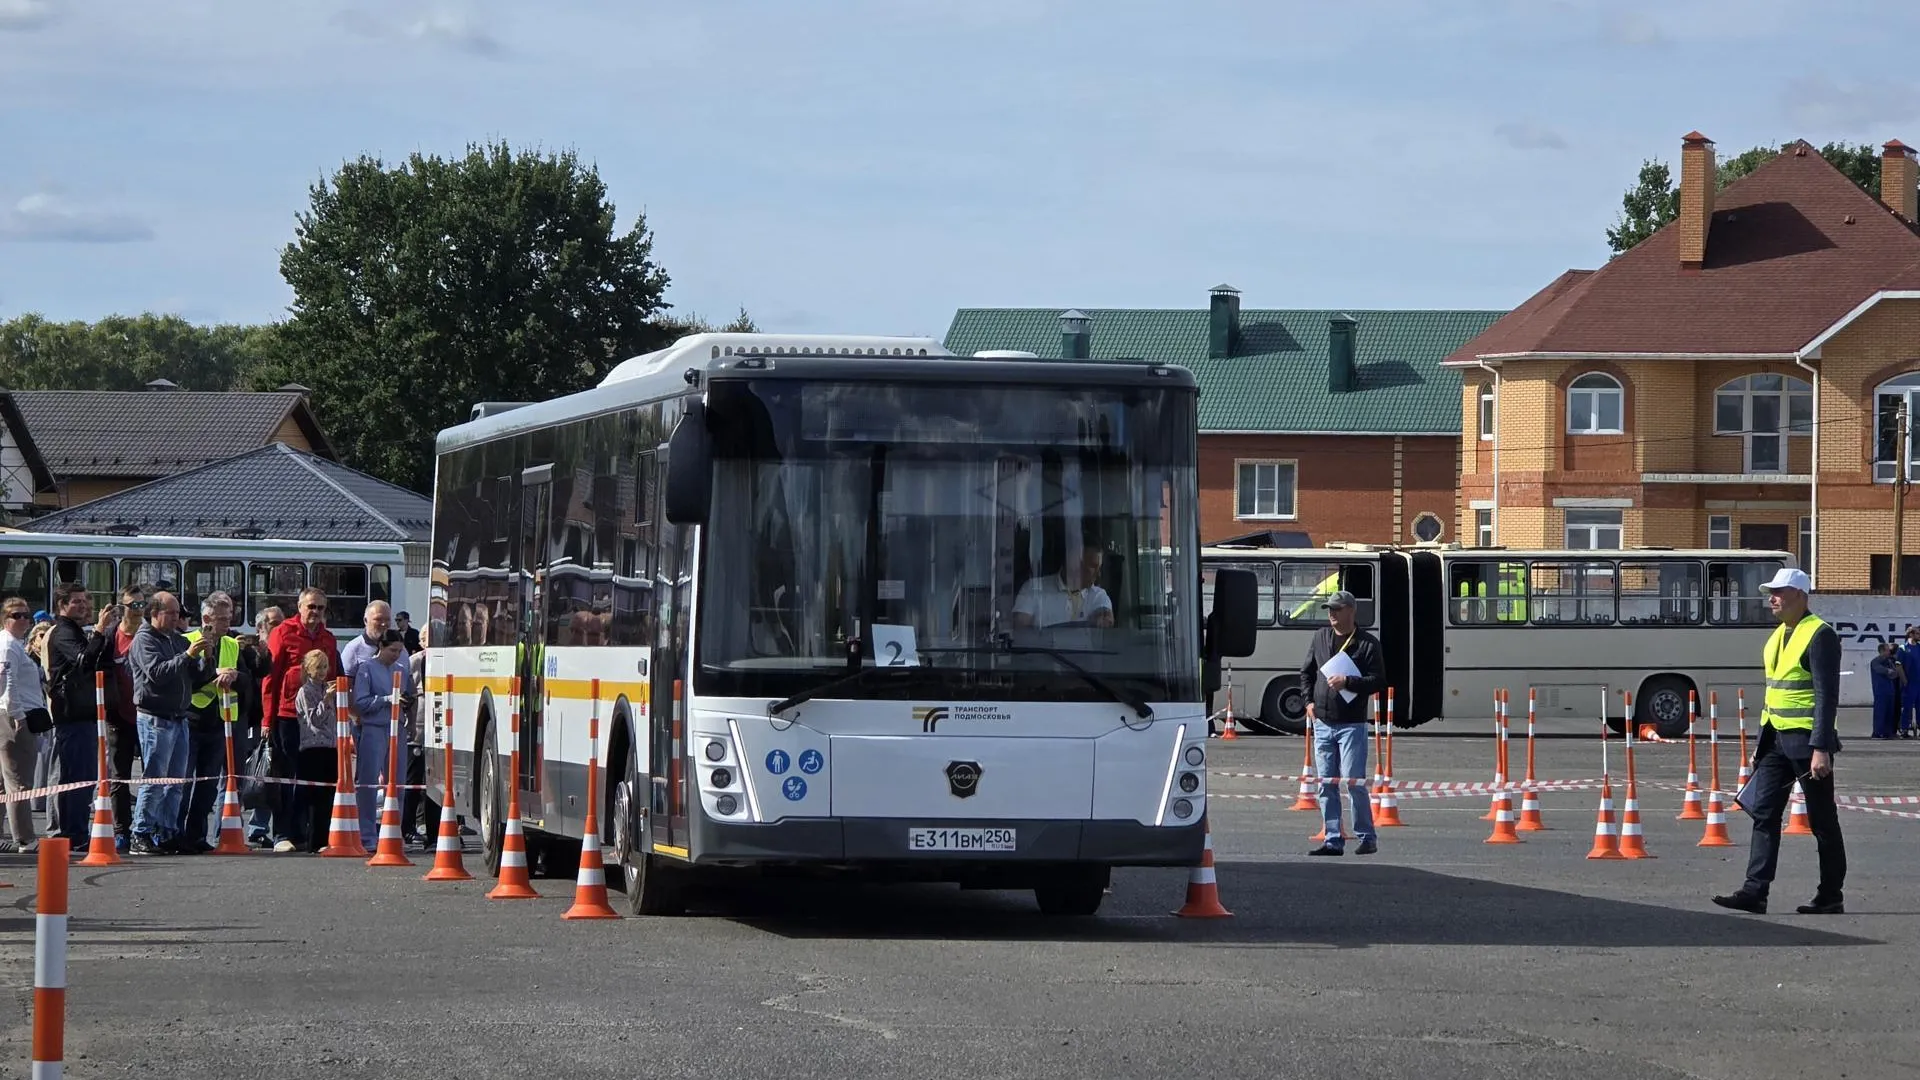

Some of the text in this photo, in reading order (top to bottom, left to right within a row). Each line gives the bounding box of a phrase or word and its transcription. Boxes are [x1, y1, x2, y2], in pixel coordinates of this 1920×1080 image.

[1827, 622, 1913, 643] РАН
[885, 641, 905, 665] 2
[915, 830, 1011, 848] Е311ВМ 250
